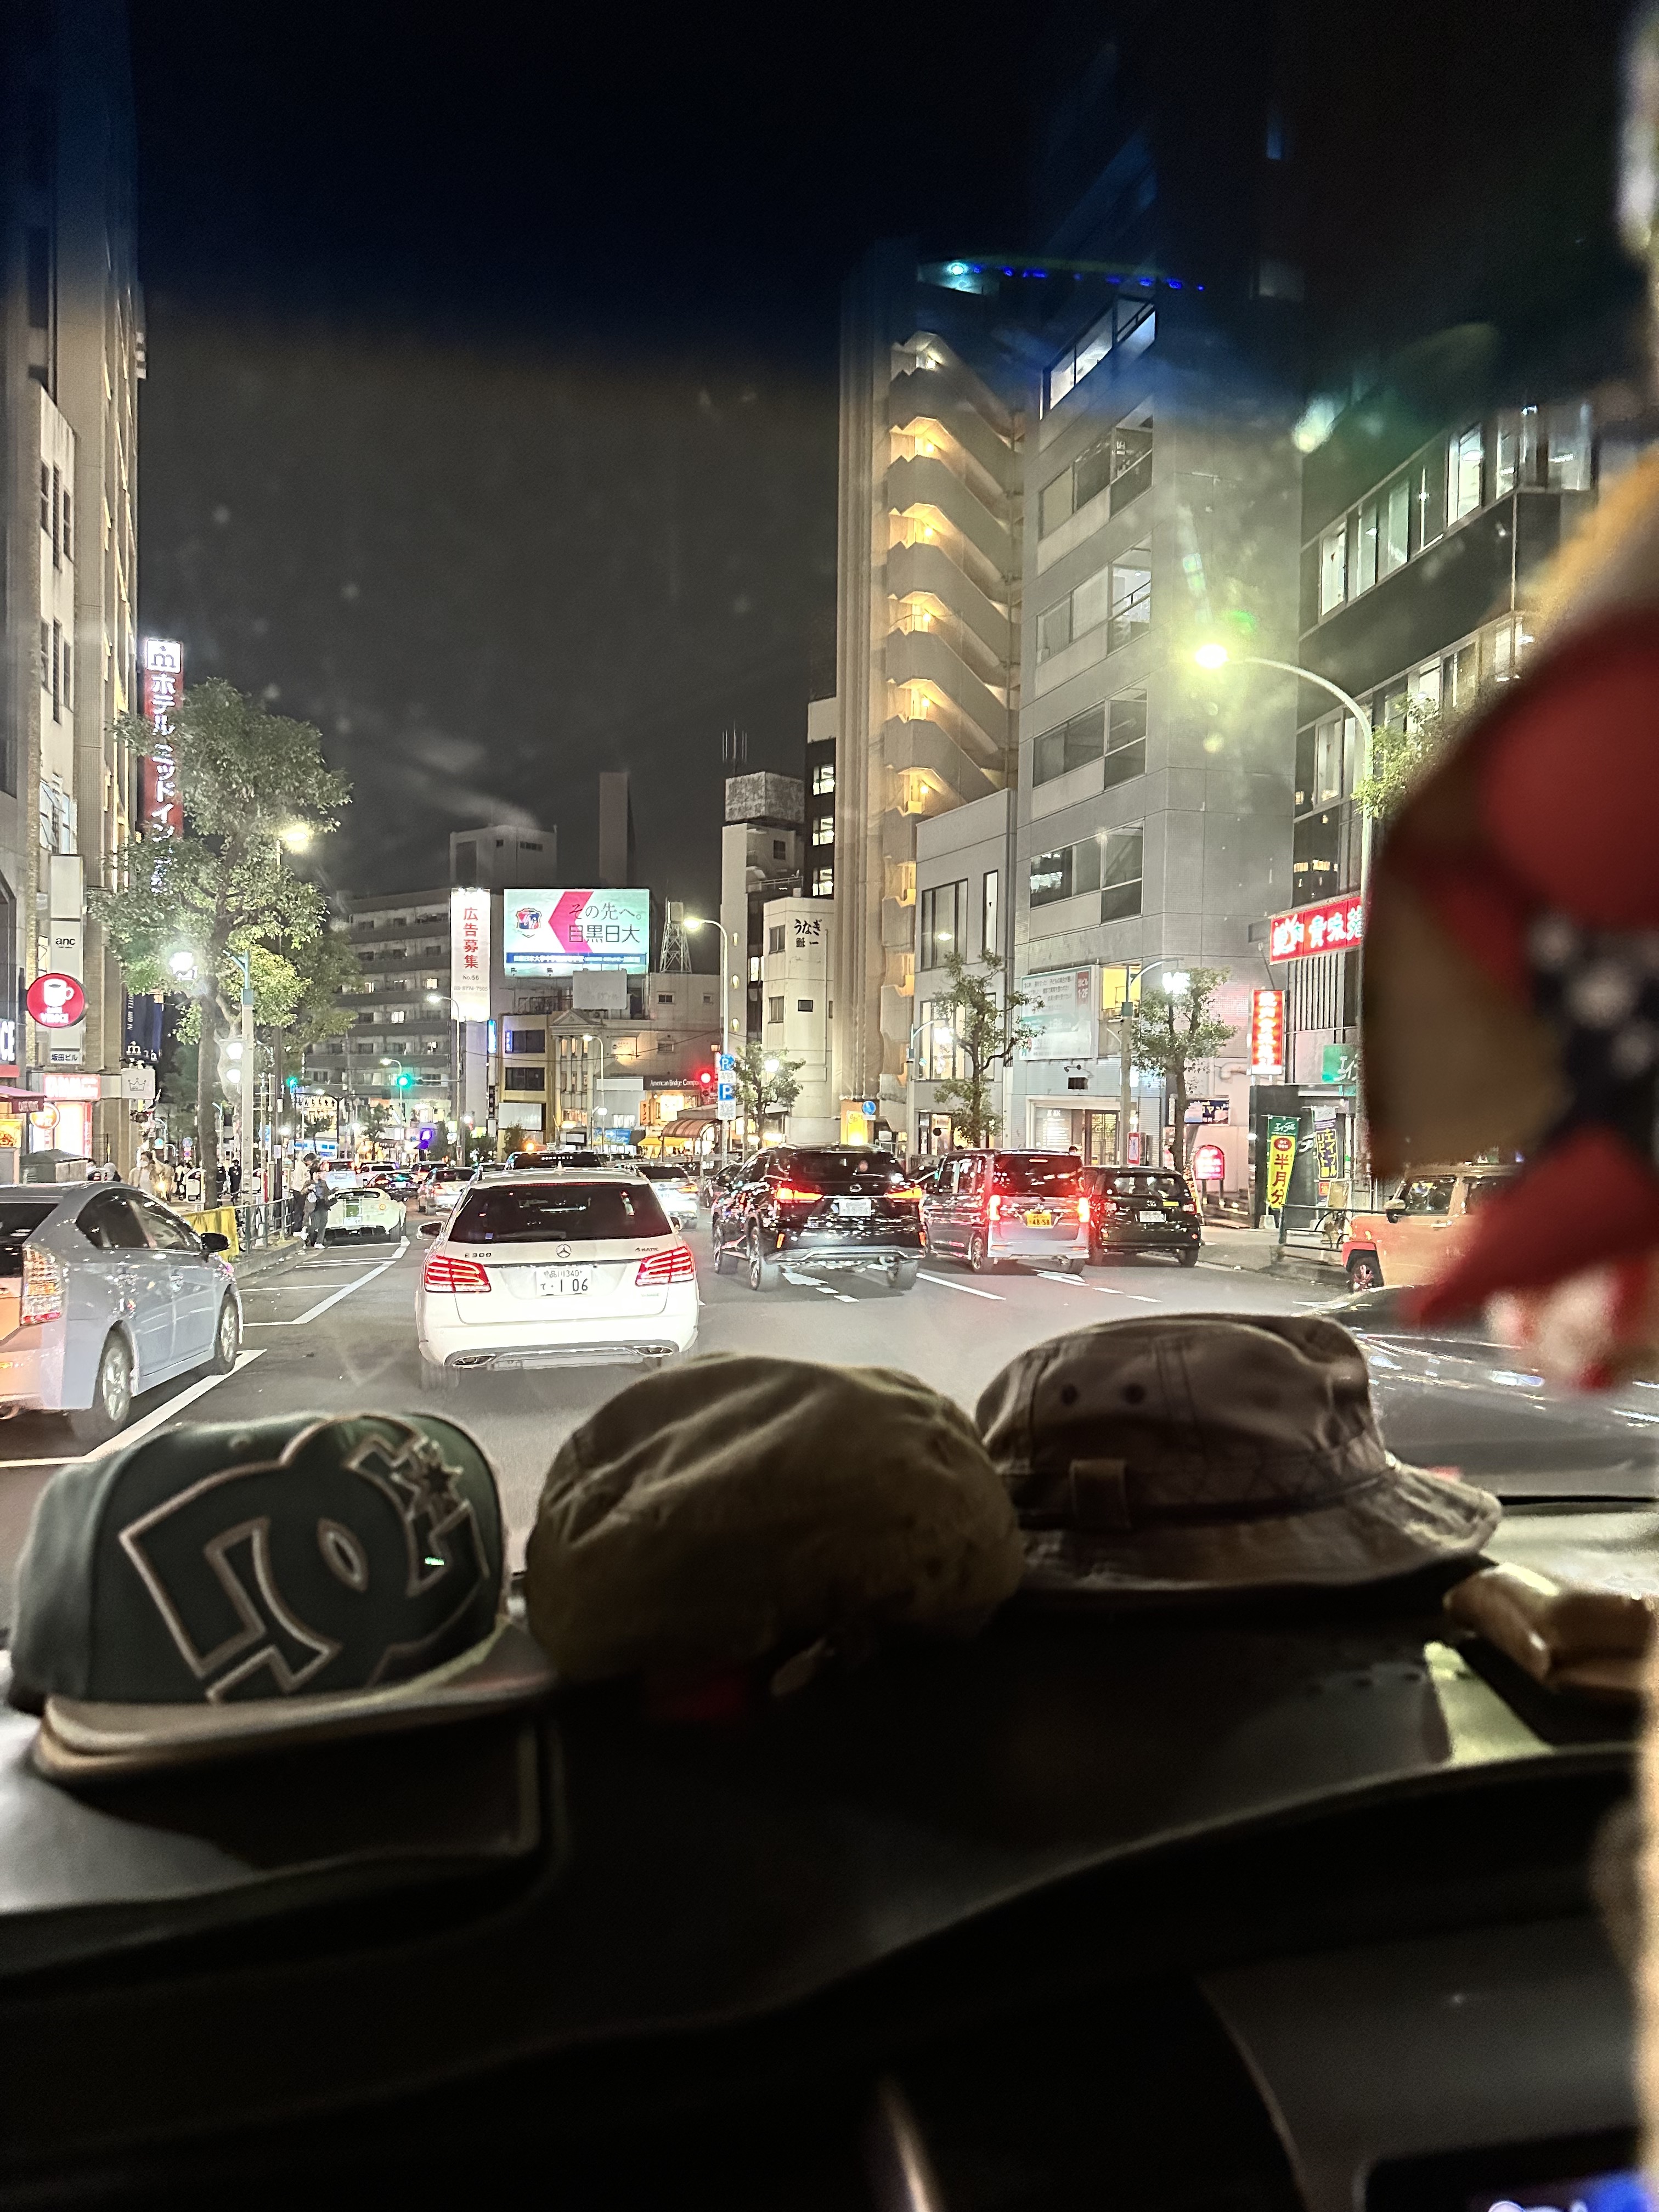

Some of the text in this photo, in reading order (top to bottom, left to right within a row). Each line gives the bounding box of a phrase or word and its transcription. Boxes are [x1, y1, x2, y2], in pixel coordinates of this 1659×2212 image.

[569, 902, 642, 921] その先へ。
[569, 924, 640, 943] 目黒日大
[794, 918, 822, 936] うなぎ
[463, 907, 478, 969] 広告募集
[51, 1053, 78, 1062] 坂田ビル
[669, 1078, 682, 1087] Bridge
[1271, 1153, 1289, 1205] 半月分
